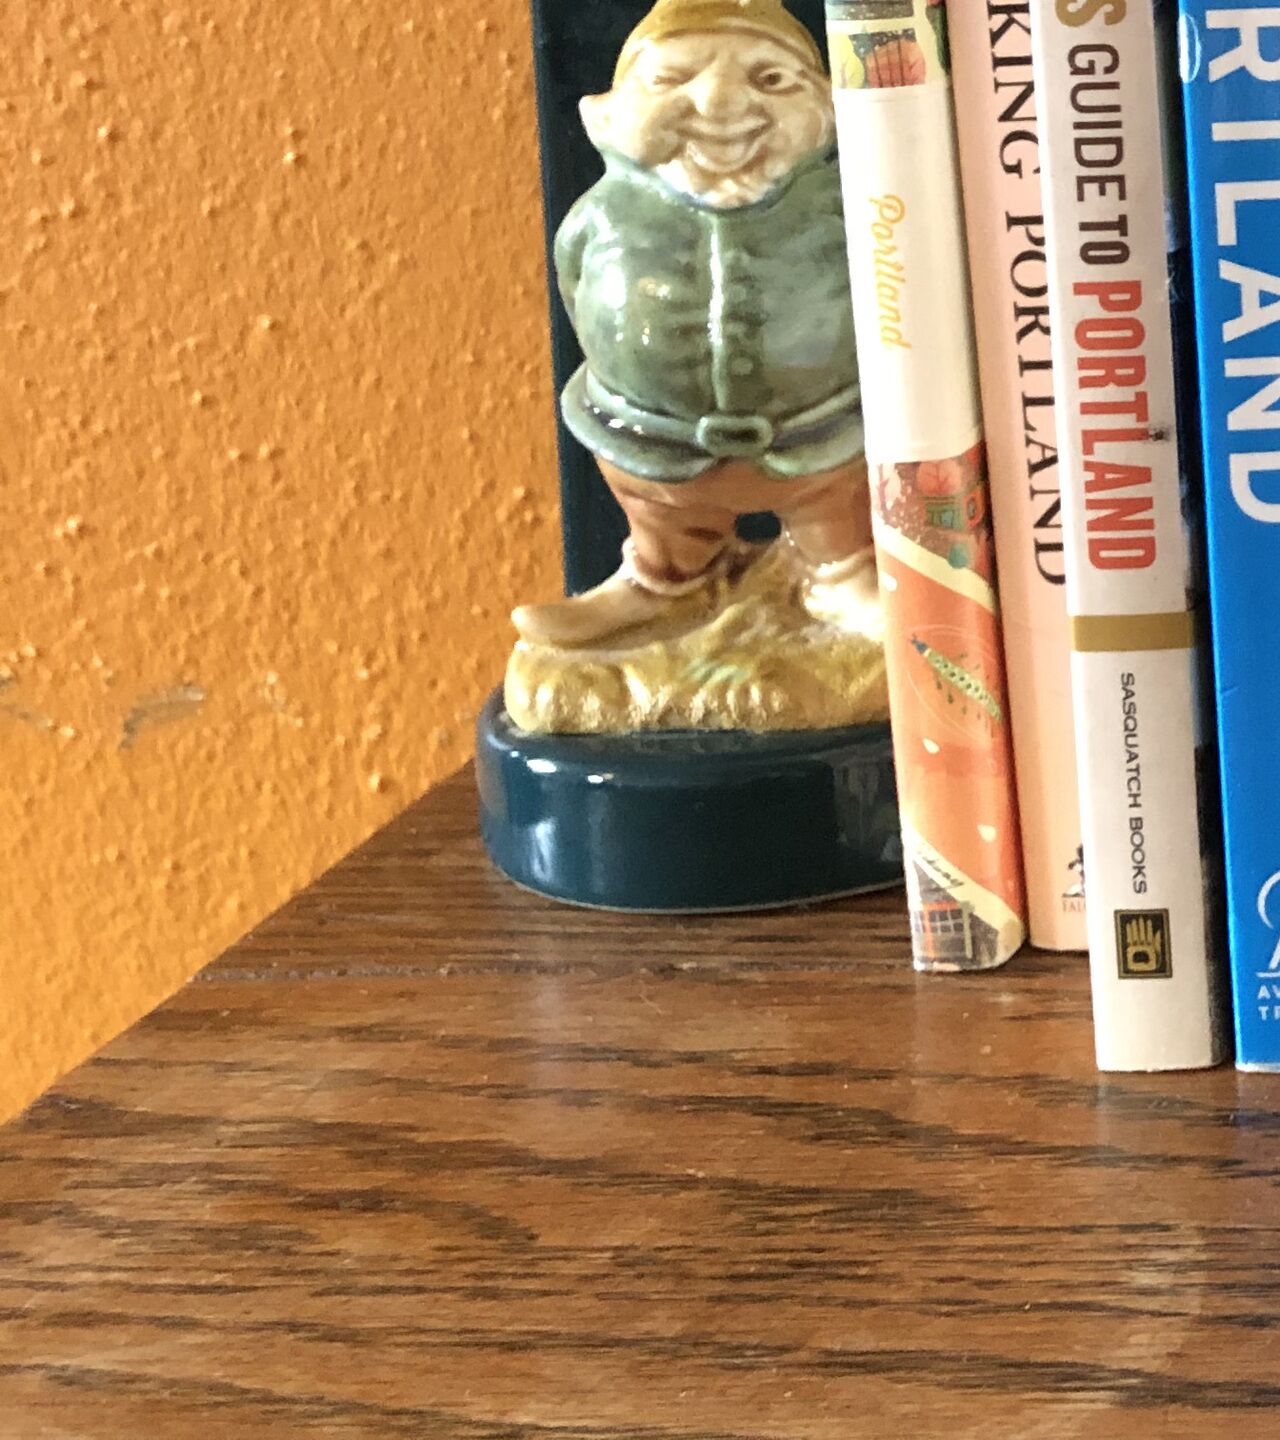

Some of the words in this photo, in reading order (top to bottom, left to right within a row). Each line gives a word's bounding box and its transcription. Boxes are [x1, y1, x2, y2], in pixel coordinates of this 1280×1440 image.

[1067, 44, 1125, 202] GUIDE
[868, 194, 910, 349] Portland
[1078, 214, 1131, 266] TO
[1006, 210, 1066, 586] PORTLAND
[1073, 280, 1156, 570] PORTLAND
[1121, 672, 1142, 808] SASQUATCH
[1129, 817, 1148, 895] BOOKS
